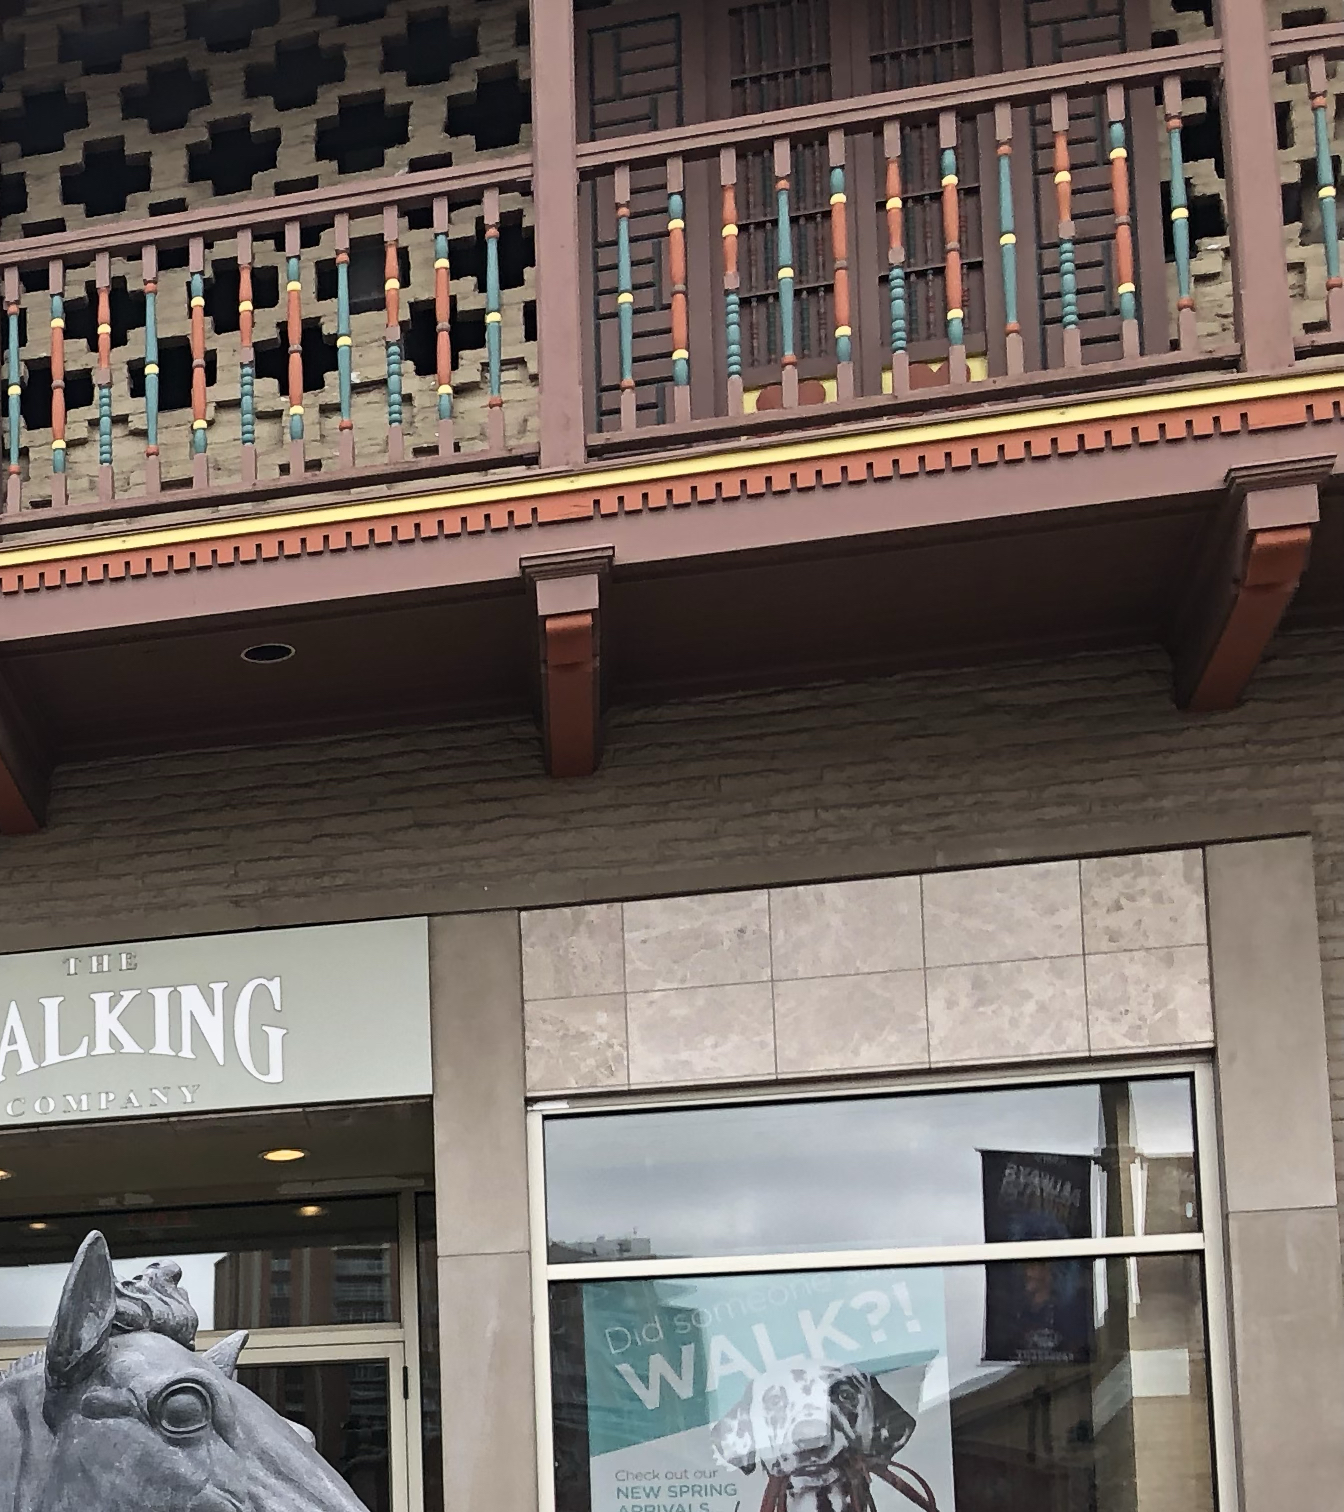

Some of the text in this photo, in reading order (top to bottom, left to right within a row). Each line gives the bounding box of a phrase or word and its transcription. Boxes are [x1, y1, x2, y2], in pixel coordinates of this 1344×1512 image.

[61, 951, 140, 977] THE
[5, 1083, 202, 1118] COMPANY
[605, 1273, 832, 1354] Did someone
[615, 1281, 922, 1410] WALK?!
[615, 1469, 718, 1481] Check out our
[616, 1483, 738, 1499] NEW SPRING
